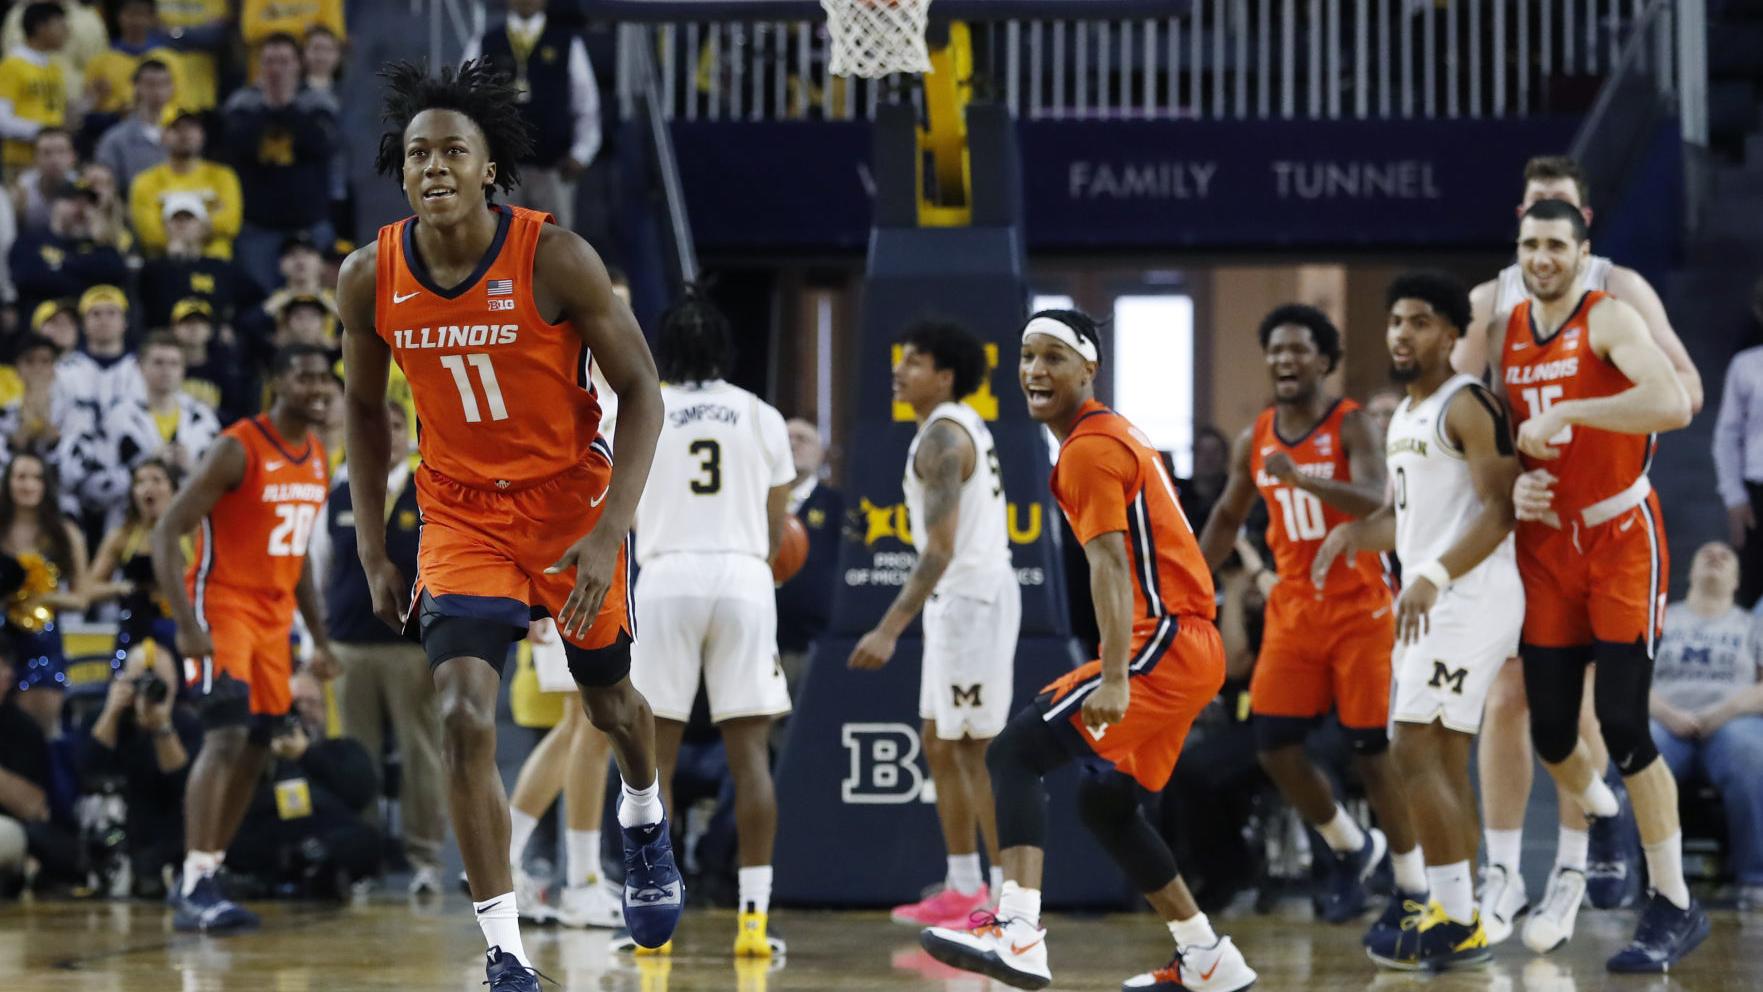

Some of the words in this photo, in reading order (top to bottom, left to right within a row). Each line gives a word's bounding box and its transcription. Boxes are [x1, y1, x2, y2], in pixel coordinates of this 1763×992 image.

[1068, 160, 1217, 200] FAMILY
[1271, 160, 1441, 200] TUNNEL
[393, 323, 520, 350] ILLINOIS
[1505, 355, 1580, 385] ILLINOIS
[439, 352, 510, 423] 11
[669, 403, 739, 429] SIMPSON
[688, 438, 723, 496] 3
[261, 483, 327, 503] ILLINOIS
[1274, 487, 1327, 542] 10
[1427, 659, 1469, 695] M
[951, 683, 983, 708] M
